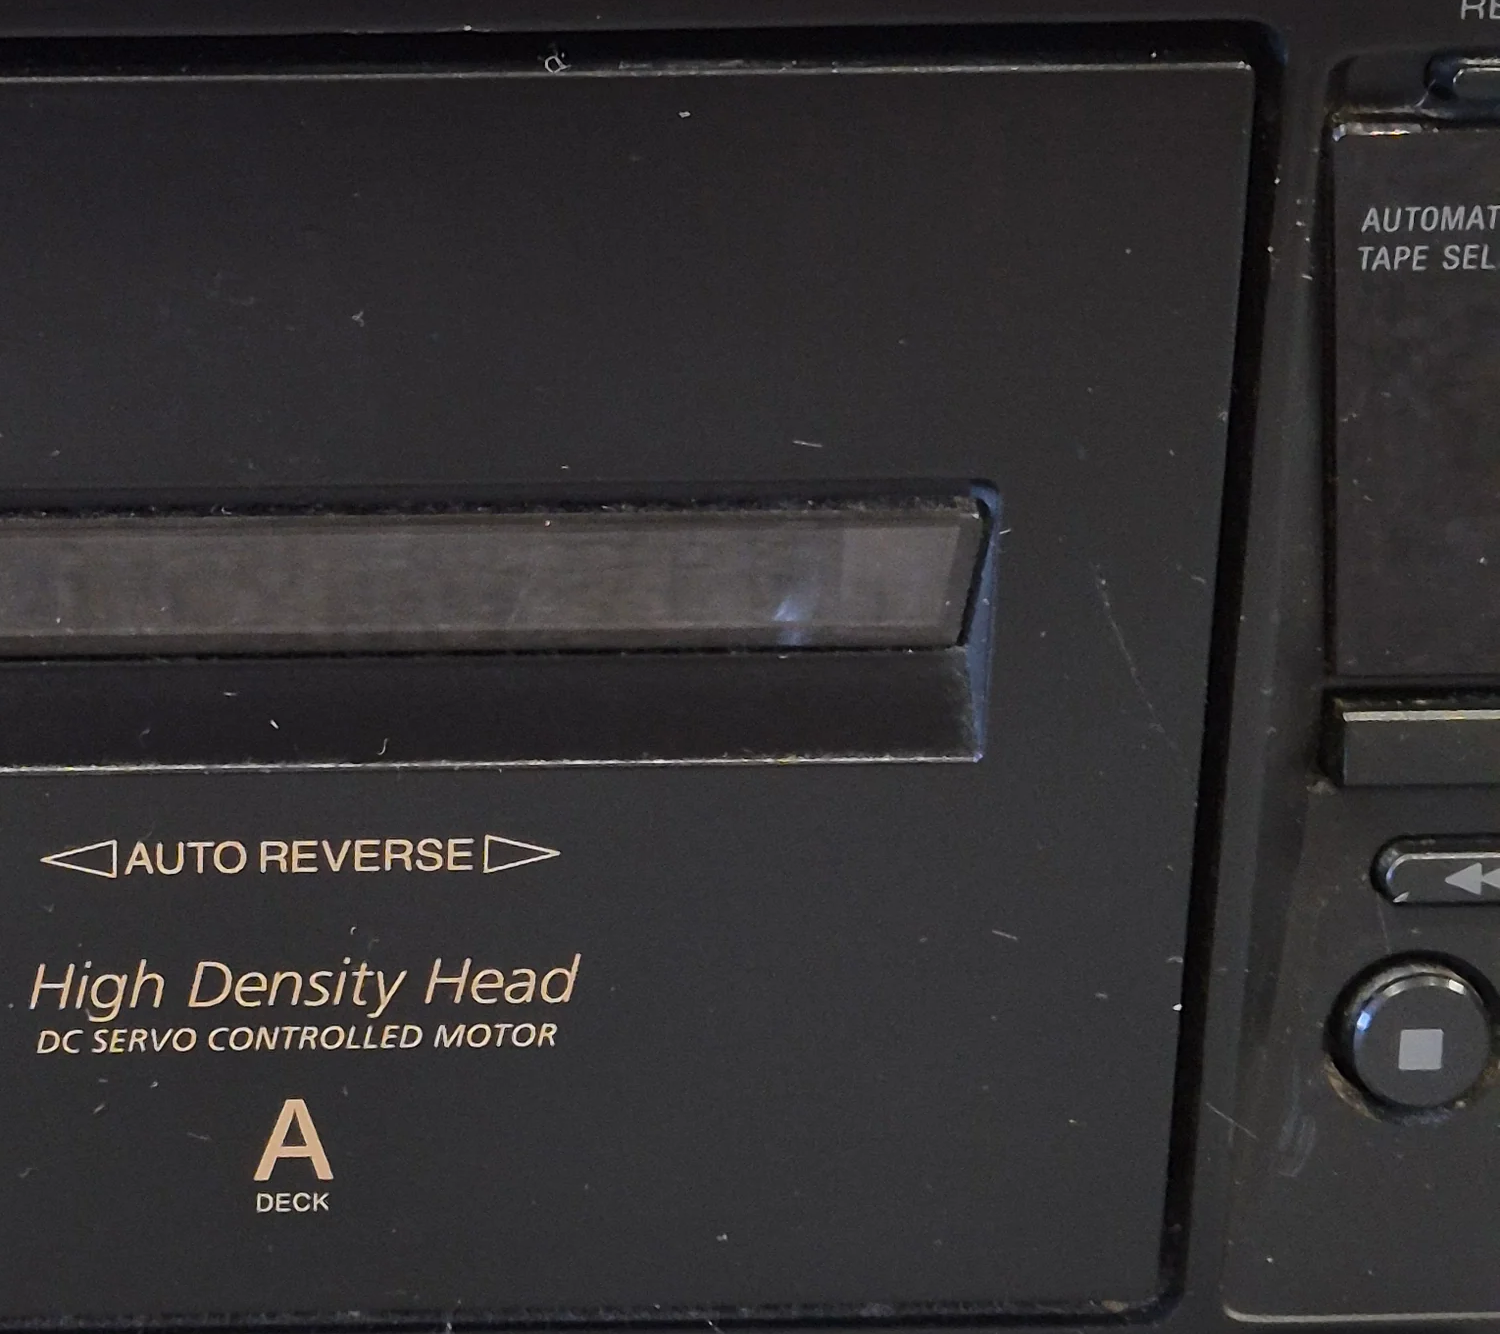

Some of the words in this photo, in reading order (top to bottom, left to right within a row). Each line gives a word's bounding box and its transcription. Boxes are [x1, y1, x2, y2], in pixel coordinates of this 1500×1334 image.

[1361, 204, 1500, 233] AUTOMAT
[1357, 244, 1429, 271] TAPE
[1442, 244, 1496, 270] SEL
[124, 840, 247, 876] AUTO
[260, 838, 475, 874] REVERSE
[29, 959, 164, 1022] High
[189, 957, 406, 1017] Density
[425, 953, 582, 1005] Head
[36, 1029, 83, 1054] DC
[91, 1028, 197, 1053] SERVO
[207, 1025, 422, 1051] CONTROLLED
[434, 1023, 558, 1048] MOTOR
[253, 1098, 334, 1182] A
[256, 1192, 330, 1213] DECK
